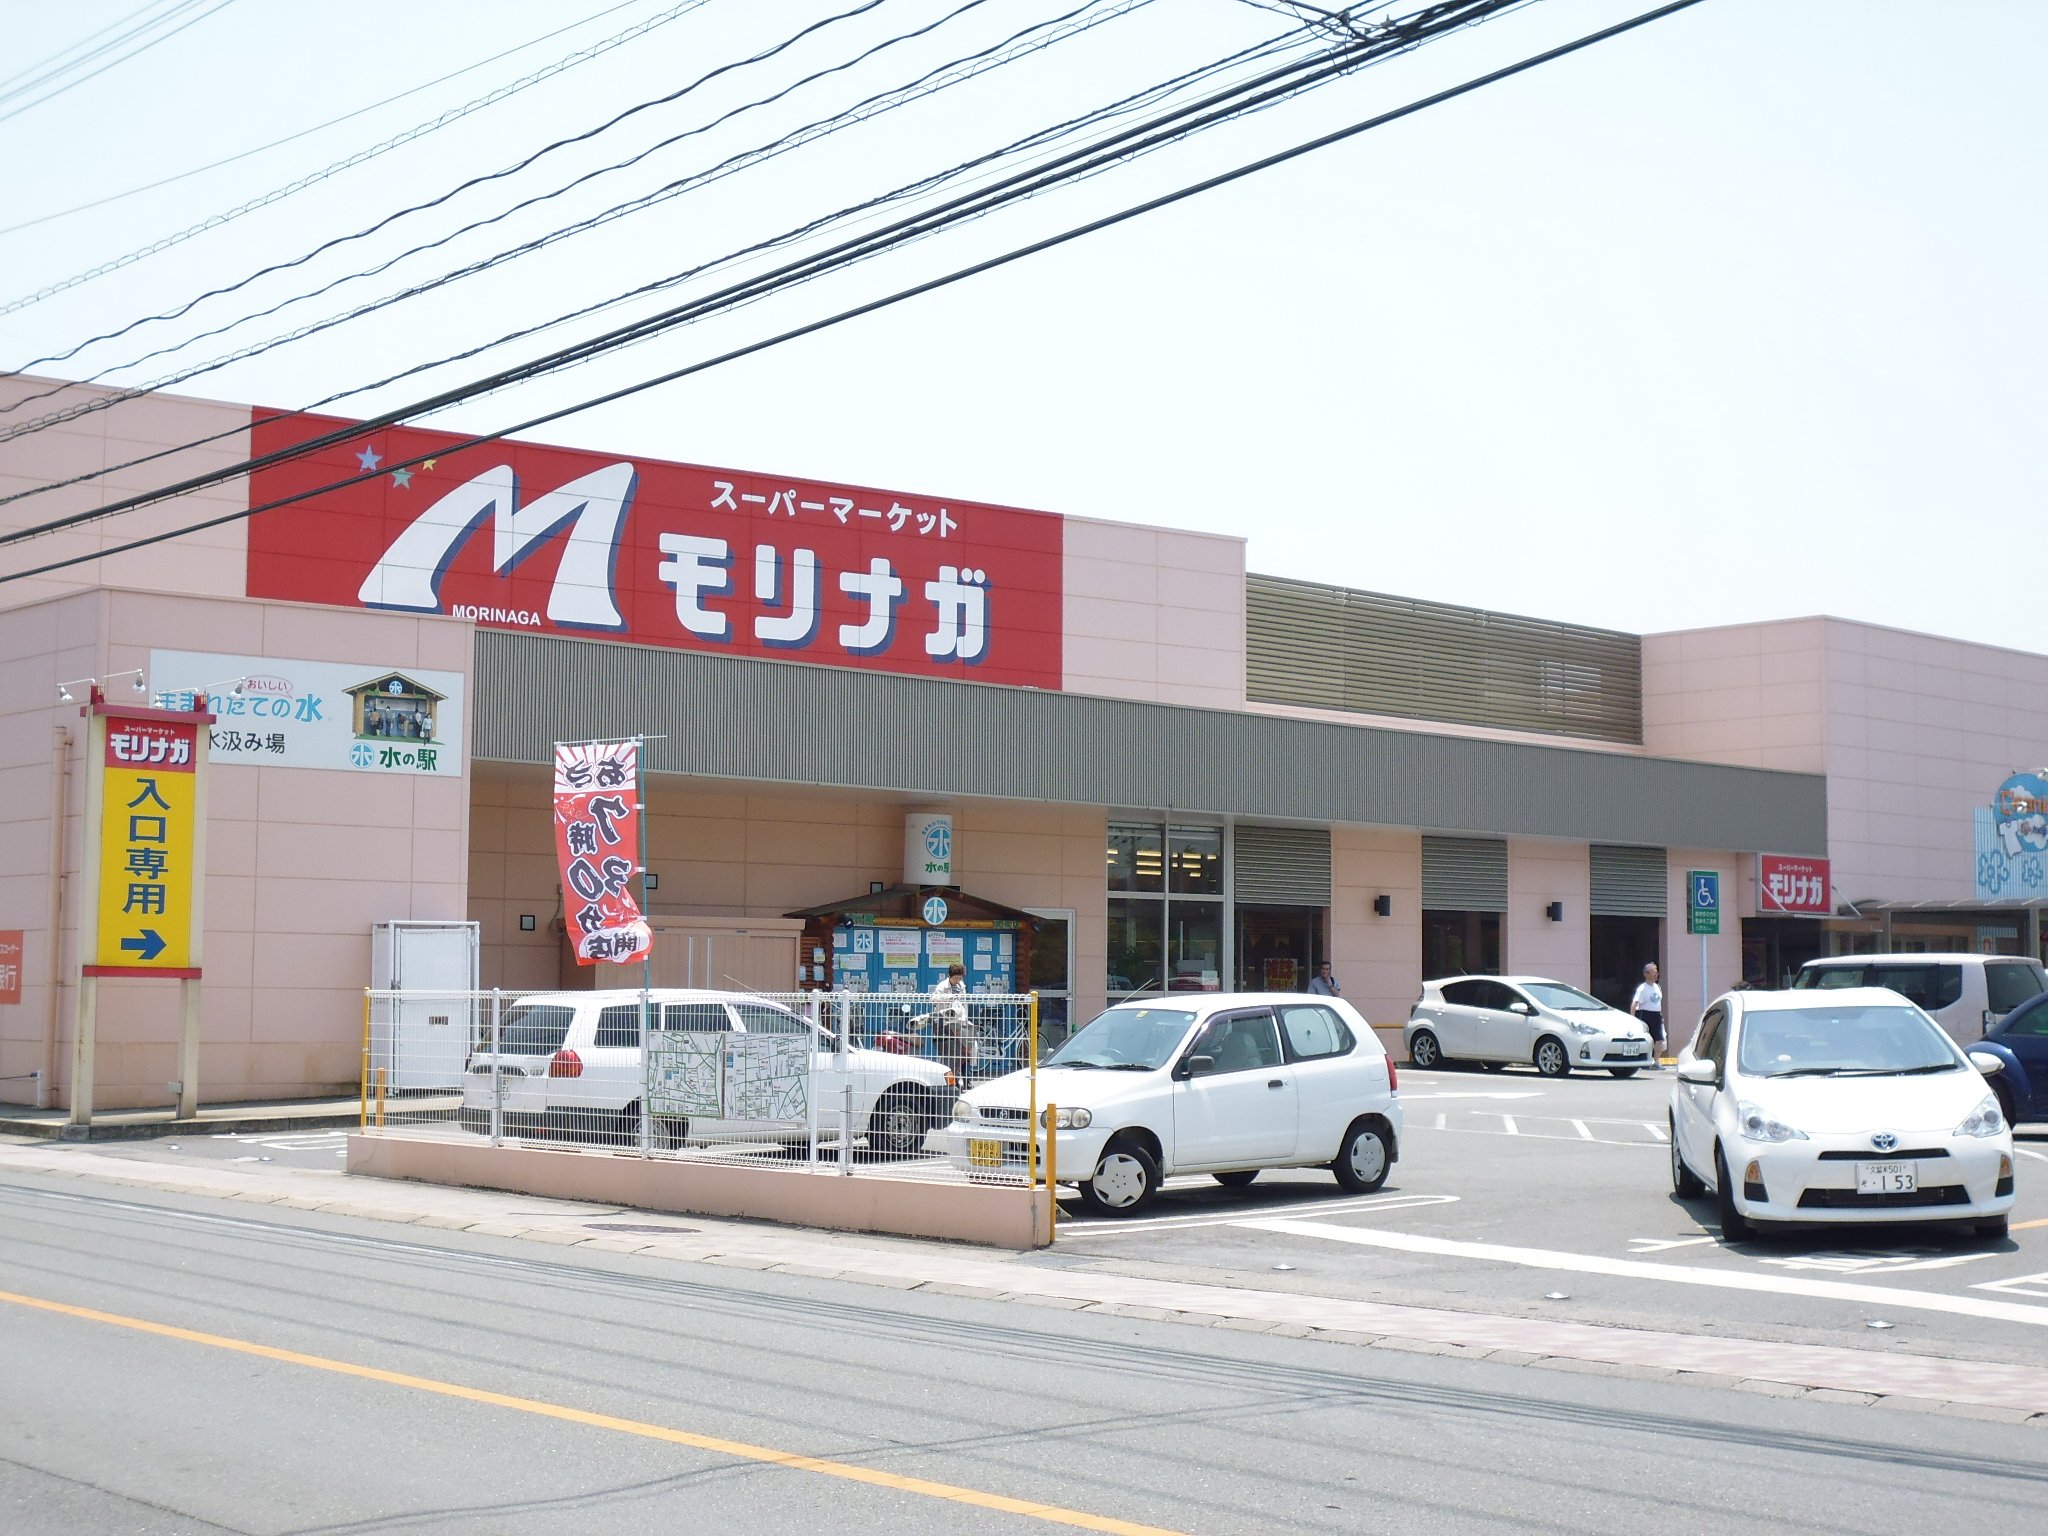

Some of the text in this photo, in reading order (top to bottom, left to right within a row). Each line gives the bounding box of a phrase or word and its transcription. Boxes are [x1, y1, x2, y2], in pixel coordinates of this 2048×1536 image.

[710, 481, 957, 538] スーパーマーケット
[658, 532, 988, 661] モリナガ
[452, 604, 541, 627] MORINAGA
[247, 679, 288, 691] おいしい
[124, 725, 175, 736] スーパーマーケット
[110, 733, 190, 765] モリナガ
[379, 746, 437, 771] 水の駅
[122, 777, 172, 915] 入口専用
[1778, 863, 1813, 874] スーパーマーケット
[1769, 873, 1823, 906] モリナガ
